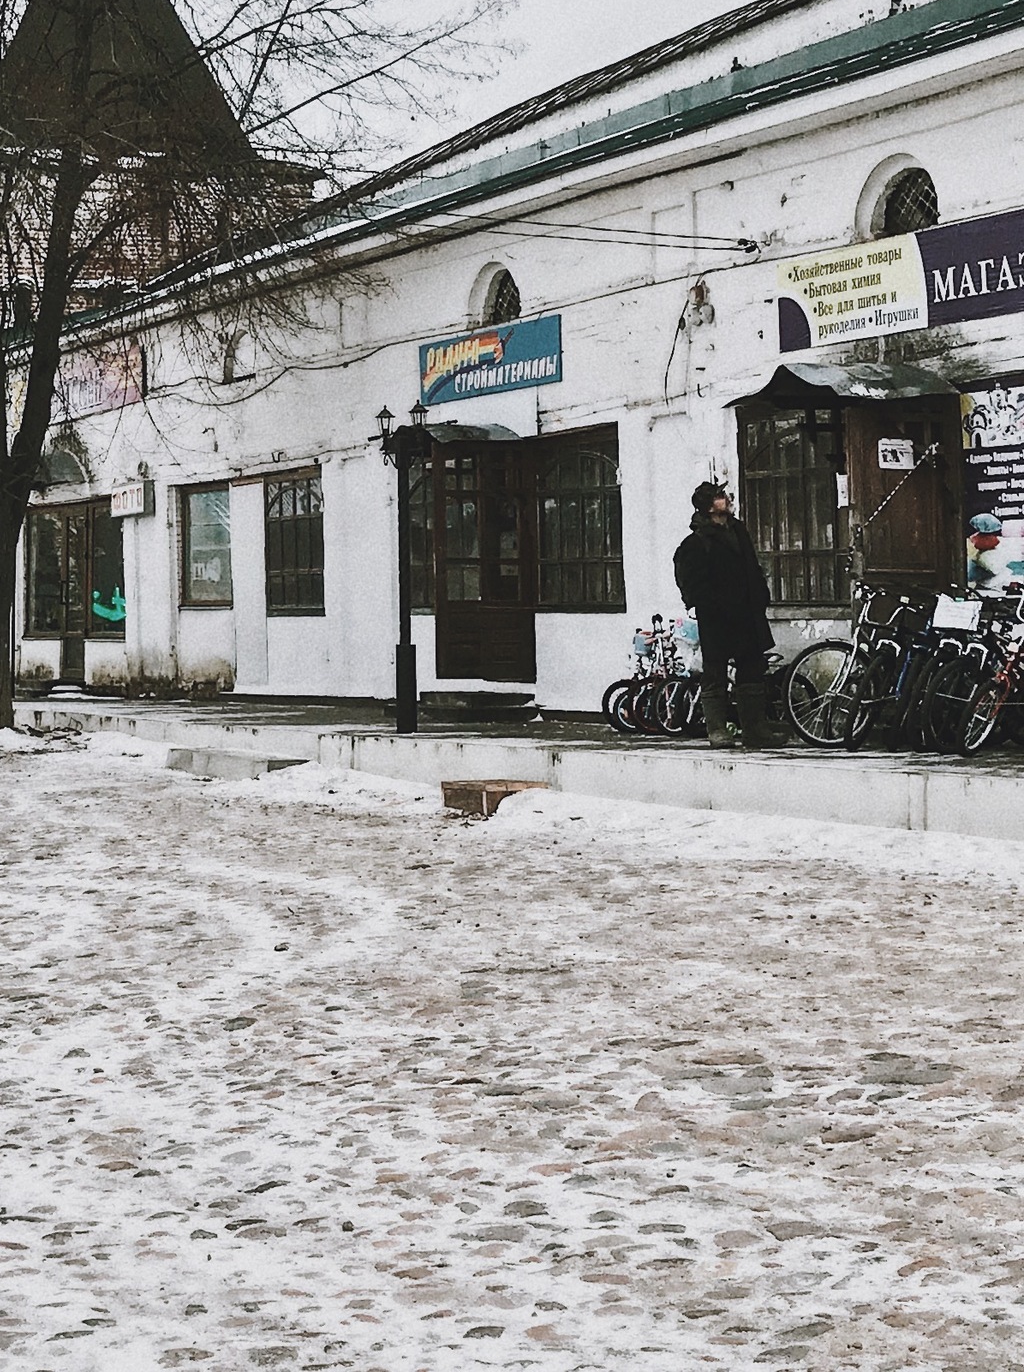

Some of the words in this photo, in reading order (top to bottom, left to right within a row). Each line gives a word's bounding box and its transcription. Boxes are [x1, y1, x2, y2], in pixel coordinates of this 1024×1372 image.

[792, 256, 864, 283] Хозяйственные
[867, 248, 902, 266] товары
[808, 280, 848, 299] Бытовая
[851, 272, 882, 290] химия
[817, 301, 834, 317] Все
[837, 299, 854, 316] для
[857, 291, 887, 310] шитья
[891, 291, 897, 303] и
[818, 317, 866, 340] рукоделия
[874, 307, 919, 328] Игрушки
[454, 354, 558, 394] СТРОЙМАТЕРИАЛЫ
[112, 487, 143, 510] ФОТО
